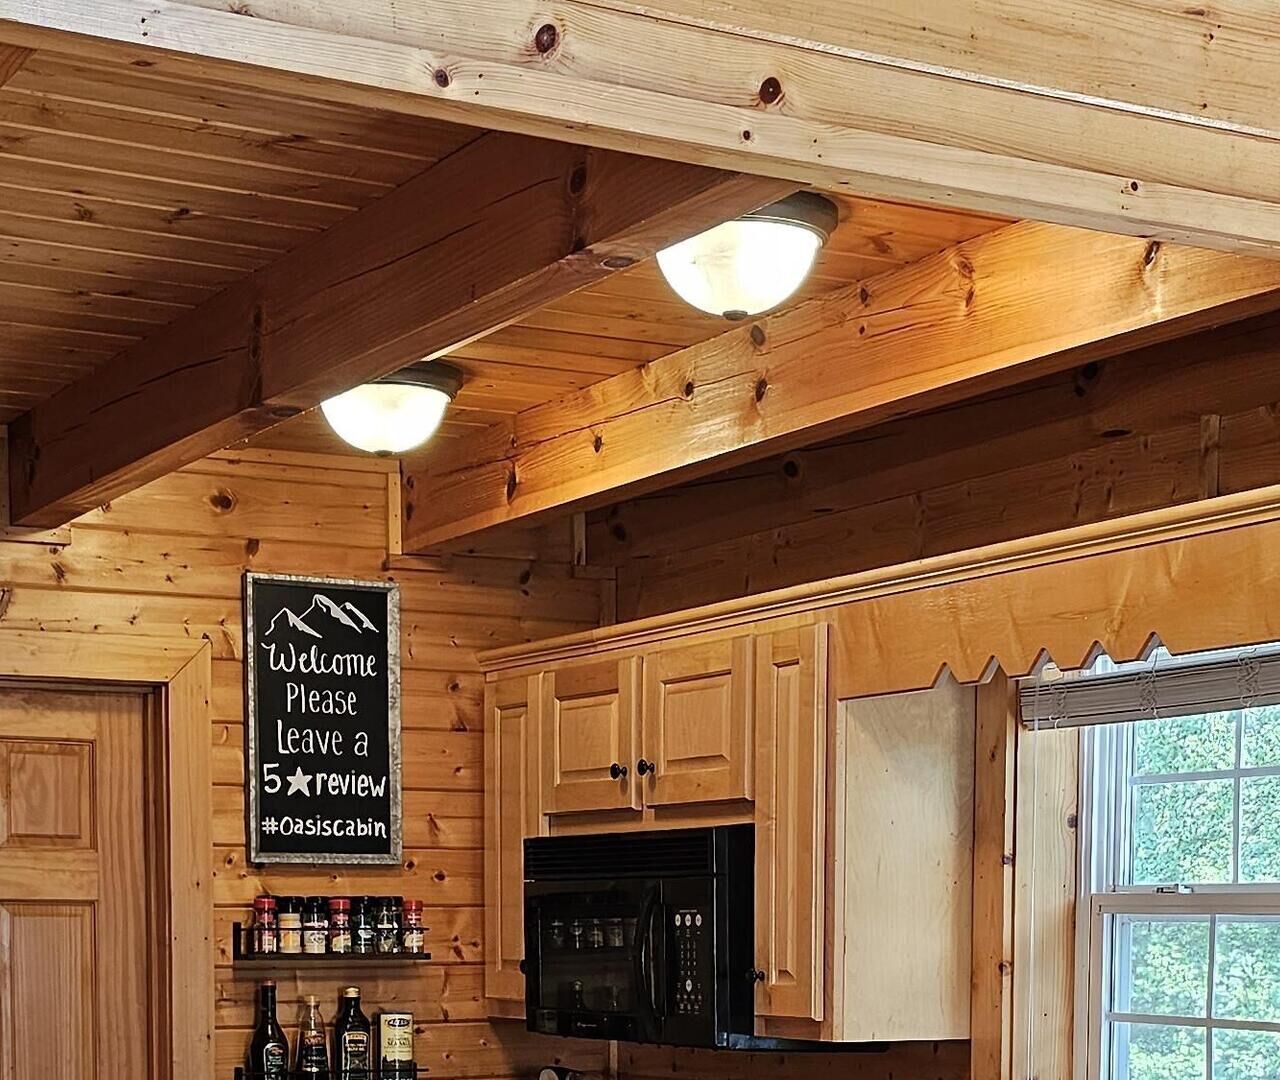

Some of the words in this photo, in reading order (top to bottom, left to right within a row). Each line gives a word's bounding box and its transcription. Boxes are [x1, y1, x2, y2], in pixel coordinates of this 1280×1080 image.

[261, 642, 377, 677] Welcome
[286, 682, 357, 715] Please
[276, 720, 343, 755] Leave
[354, 732, 369, 757] a
[263, 763, 282, 794] 5
[316, 770, 387, 797] review
